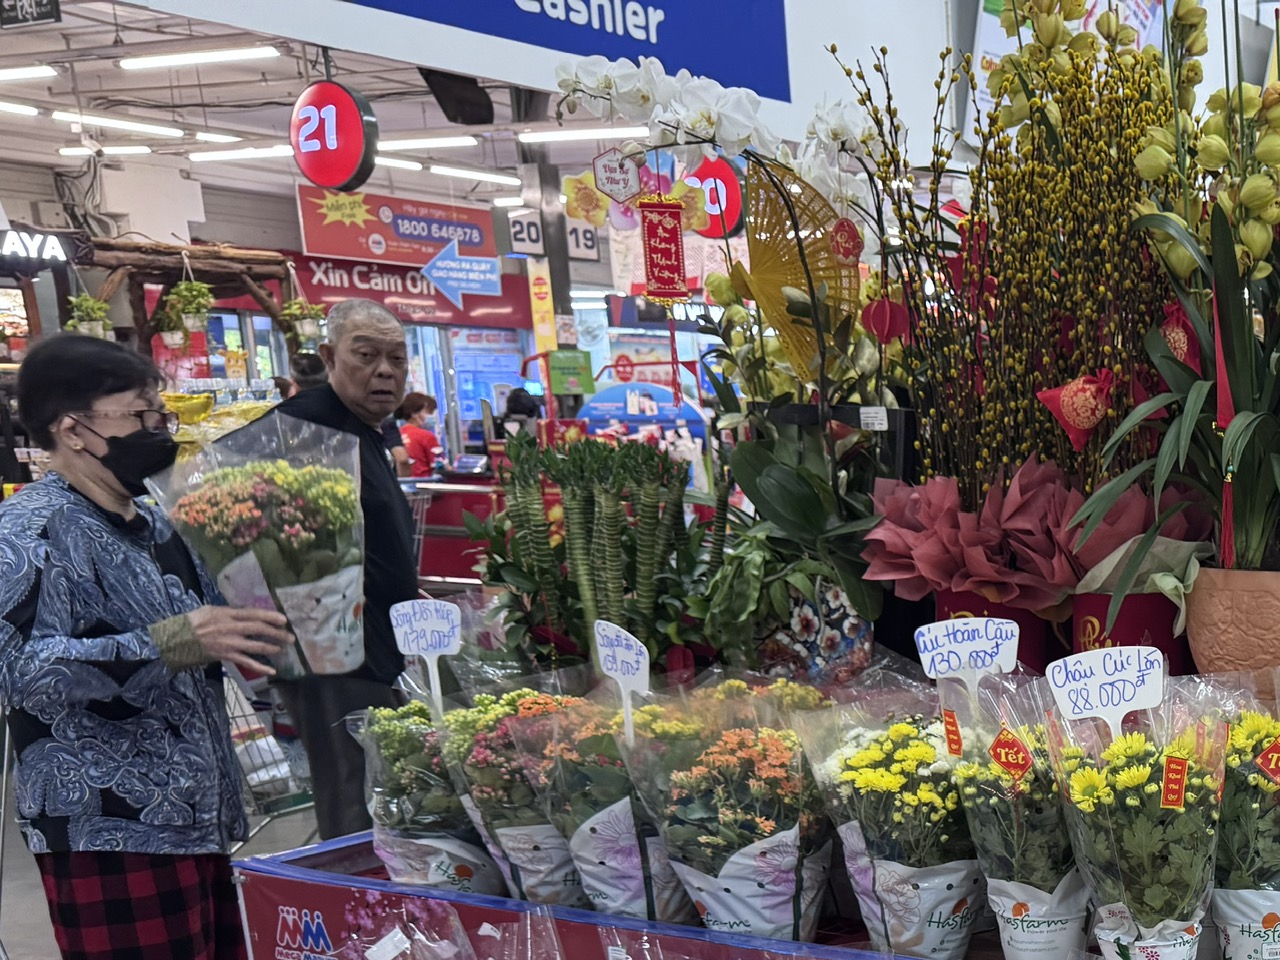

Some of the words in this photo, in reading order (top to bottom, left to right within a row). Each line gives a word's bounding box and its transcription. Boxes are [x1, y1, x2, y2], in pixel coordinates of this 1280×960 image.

[298, 103, 338, 153] 21
[397, 218, 428, 237] 1800
[511, 219, 541, 244] 20
[569, 227, 596, 250] 19
[2, 231, 67, 261] AYA
[309, 261, 349, 289] Xin
[352, 265, 403, 294] Cảm
[997, 746, 1026, 765] Tết
